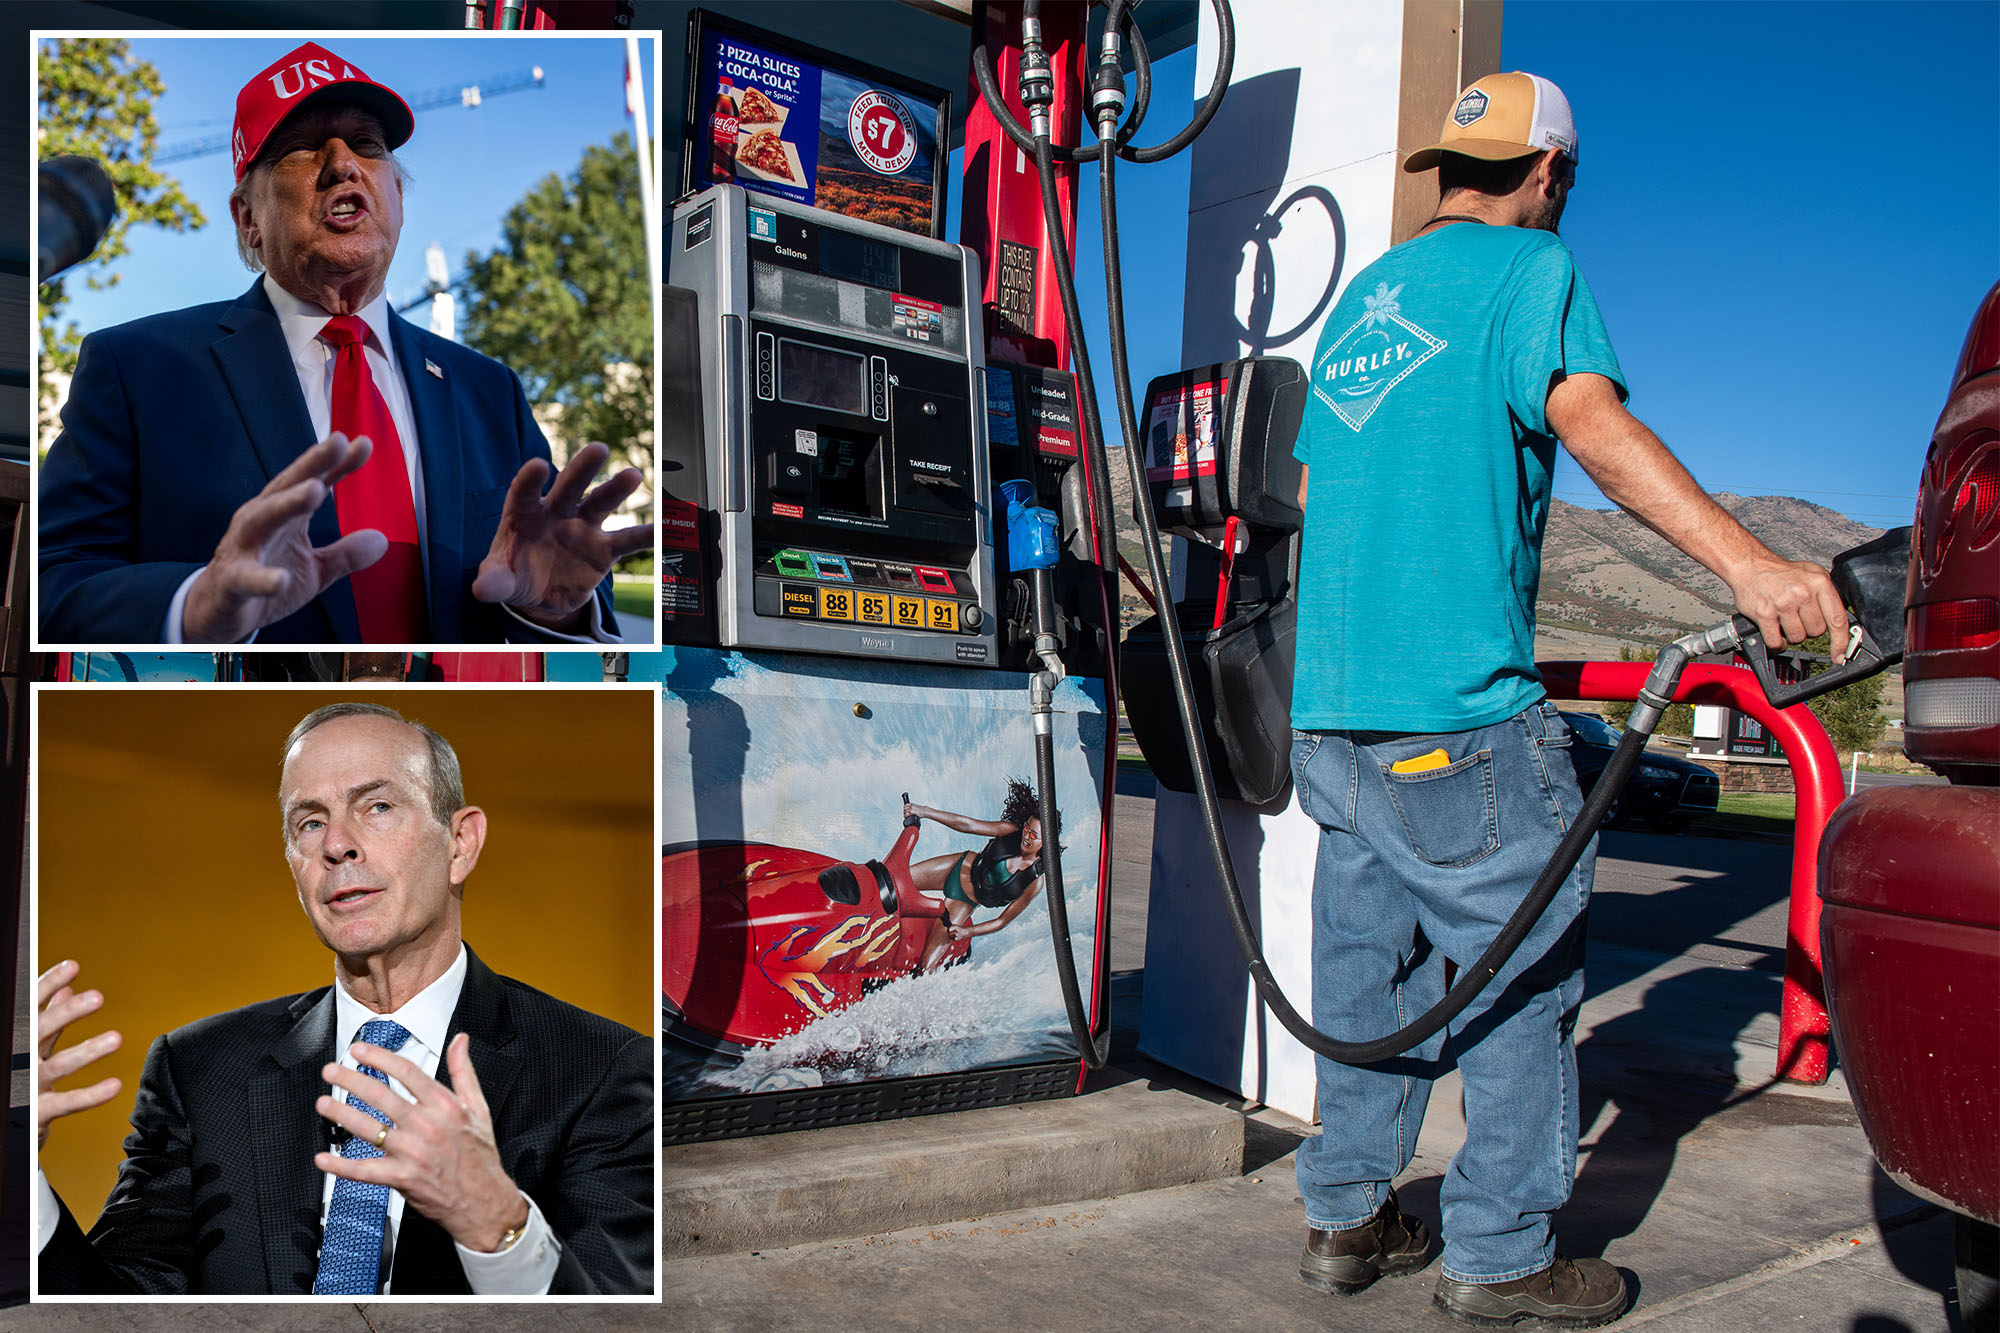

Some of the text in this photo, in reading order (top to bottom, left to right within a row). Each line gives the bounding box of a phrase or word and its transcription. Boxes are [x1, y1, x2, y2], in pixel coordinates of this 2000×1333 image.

[717, 43, 800, 78] 2 PIZZA SLICES
[773, 91, 793, 103] Sprite
[855, 95, 913, 135] FEED YOUR FIRE
[868, 116, 896, 150] $7
[857, 141, 908, 169] MEAL DEAL
[802, 229, 807, 239] $
[775, 245, 808, 260] Gallons
[1003, 244, 1032, 271] THIS FUEL
[1002, 265, 1032, 293] CONTAINS
[1001, 287, 1010, 308] UP
[1011, 289, 1019, 311] TO
[1325, 342, 1409, 381] HURLEY
[1031, 385, 1067, 399] Unleaded
[1181, 391, 1193, 401] GET
[1193, 387, 1205, 398] ONE
[1205, 385, 1220, 397] FREE
[1031, 408, 1071, 423] Mid-Grade
[1038, 433, 1071, 447] Premium
[909, 459, 952, 472] TAKE RECEIPT
[672, 519, 696, 528] INSIDE
[850, 560, 876, 568] Unleaded
[884, 564, 912, 572] Mid-Grade
[662, 574, 698, 584] ENTION
[784, 592, 814, 604] DIESEL
[826, 594, 848, 611] 88
[863, 598, 884, 615] 85
[898, 602, 918, 618] 87
[934, 605, 951, 622] 91
[862, 637, 889, 649] Wayne
